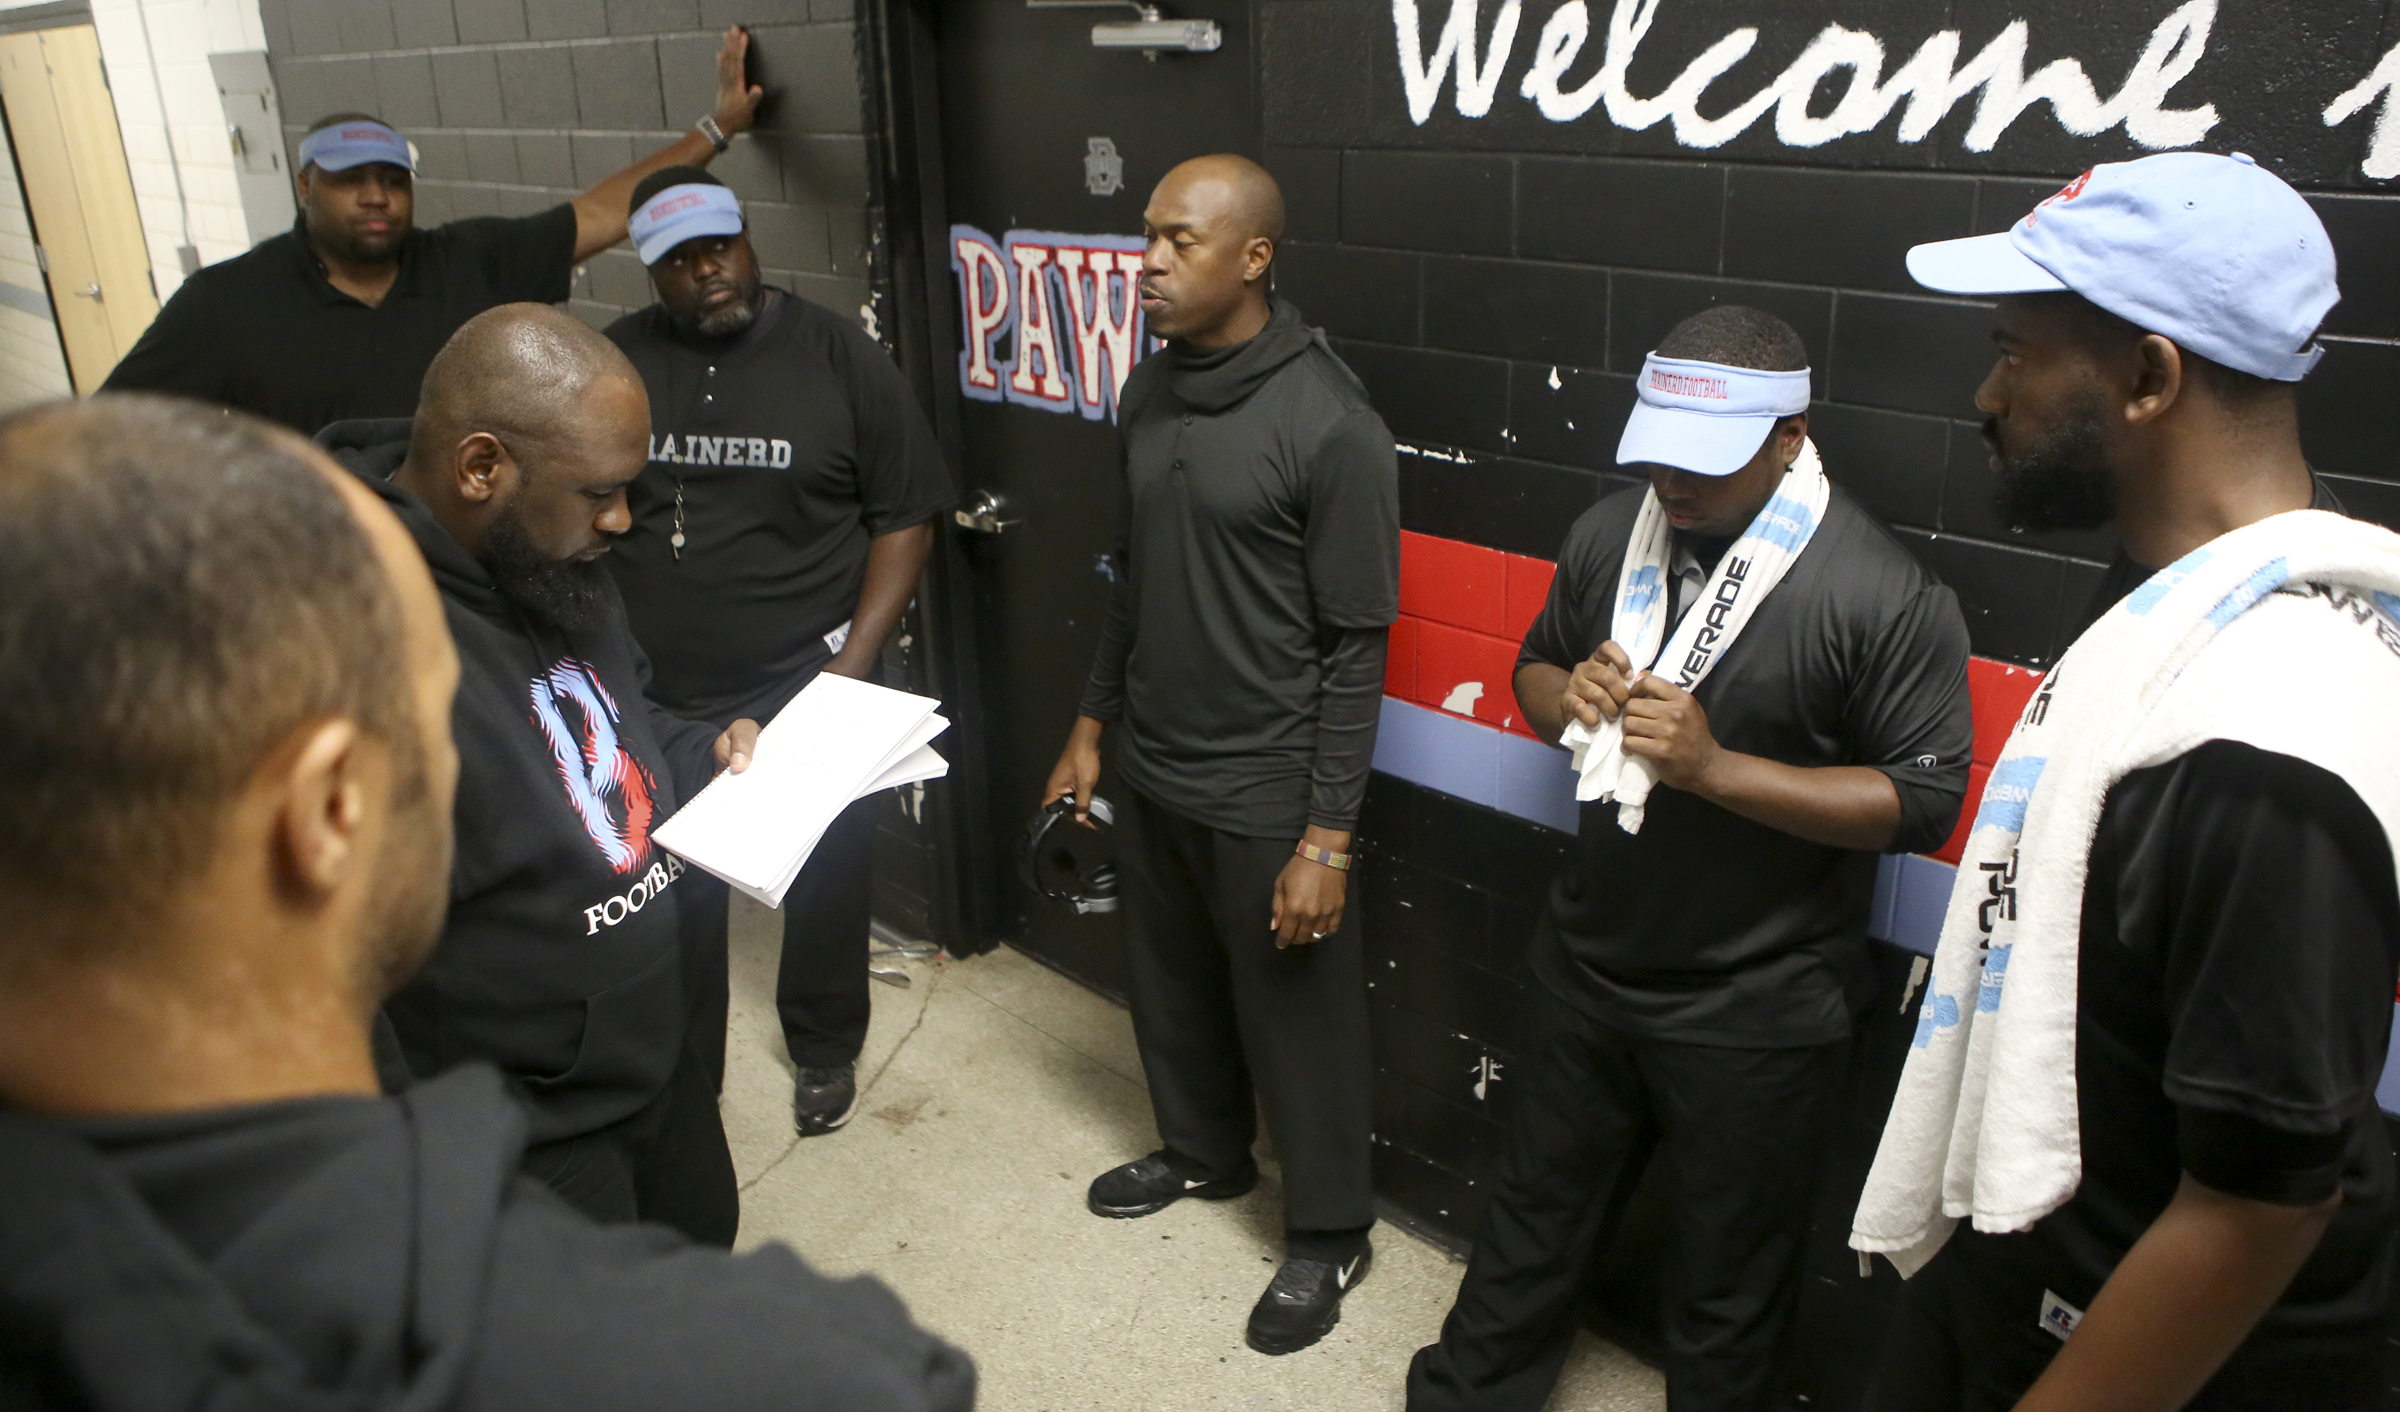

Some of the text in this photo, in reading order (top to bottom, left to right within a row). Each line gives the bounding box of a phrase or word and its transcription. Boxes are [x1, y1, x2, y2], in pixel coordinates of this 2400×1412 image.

[1391, 0, 2219, 152] Welcome
[955, 235, 1147, 412] PAW
[1682, 376, 1728, 399] FOOTBALL
[648, 432, 792, 470] AINERD
[1760, 510, 1802, 535] ERADE
[584, 853, 687, 936] FOOTBA
